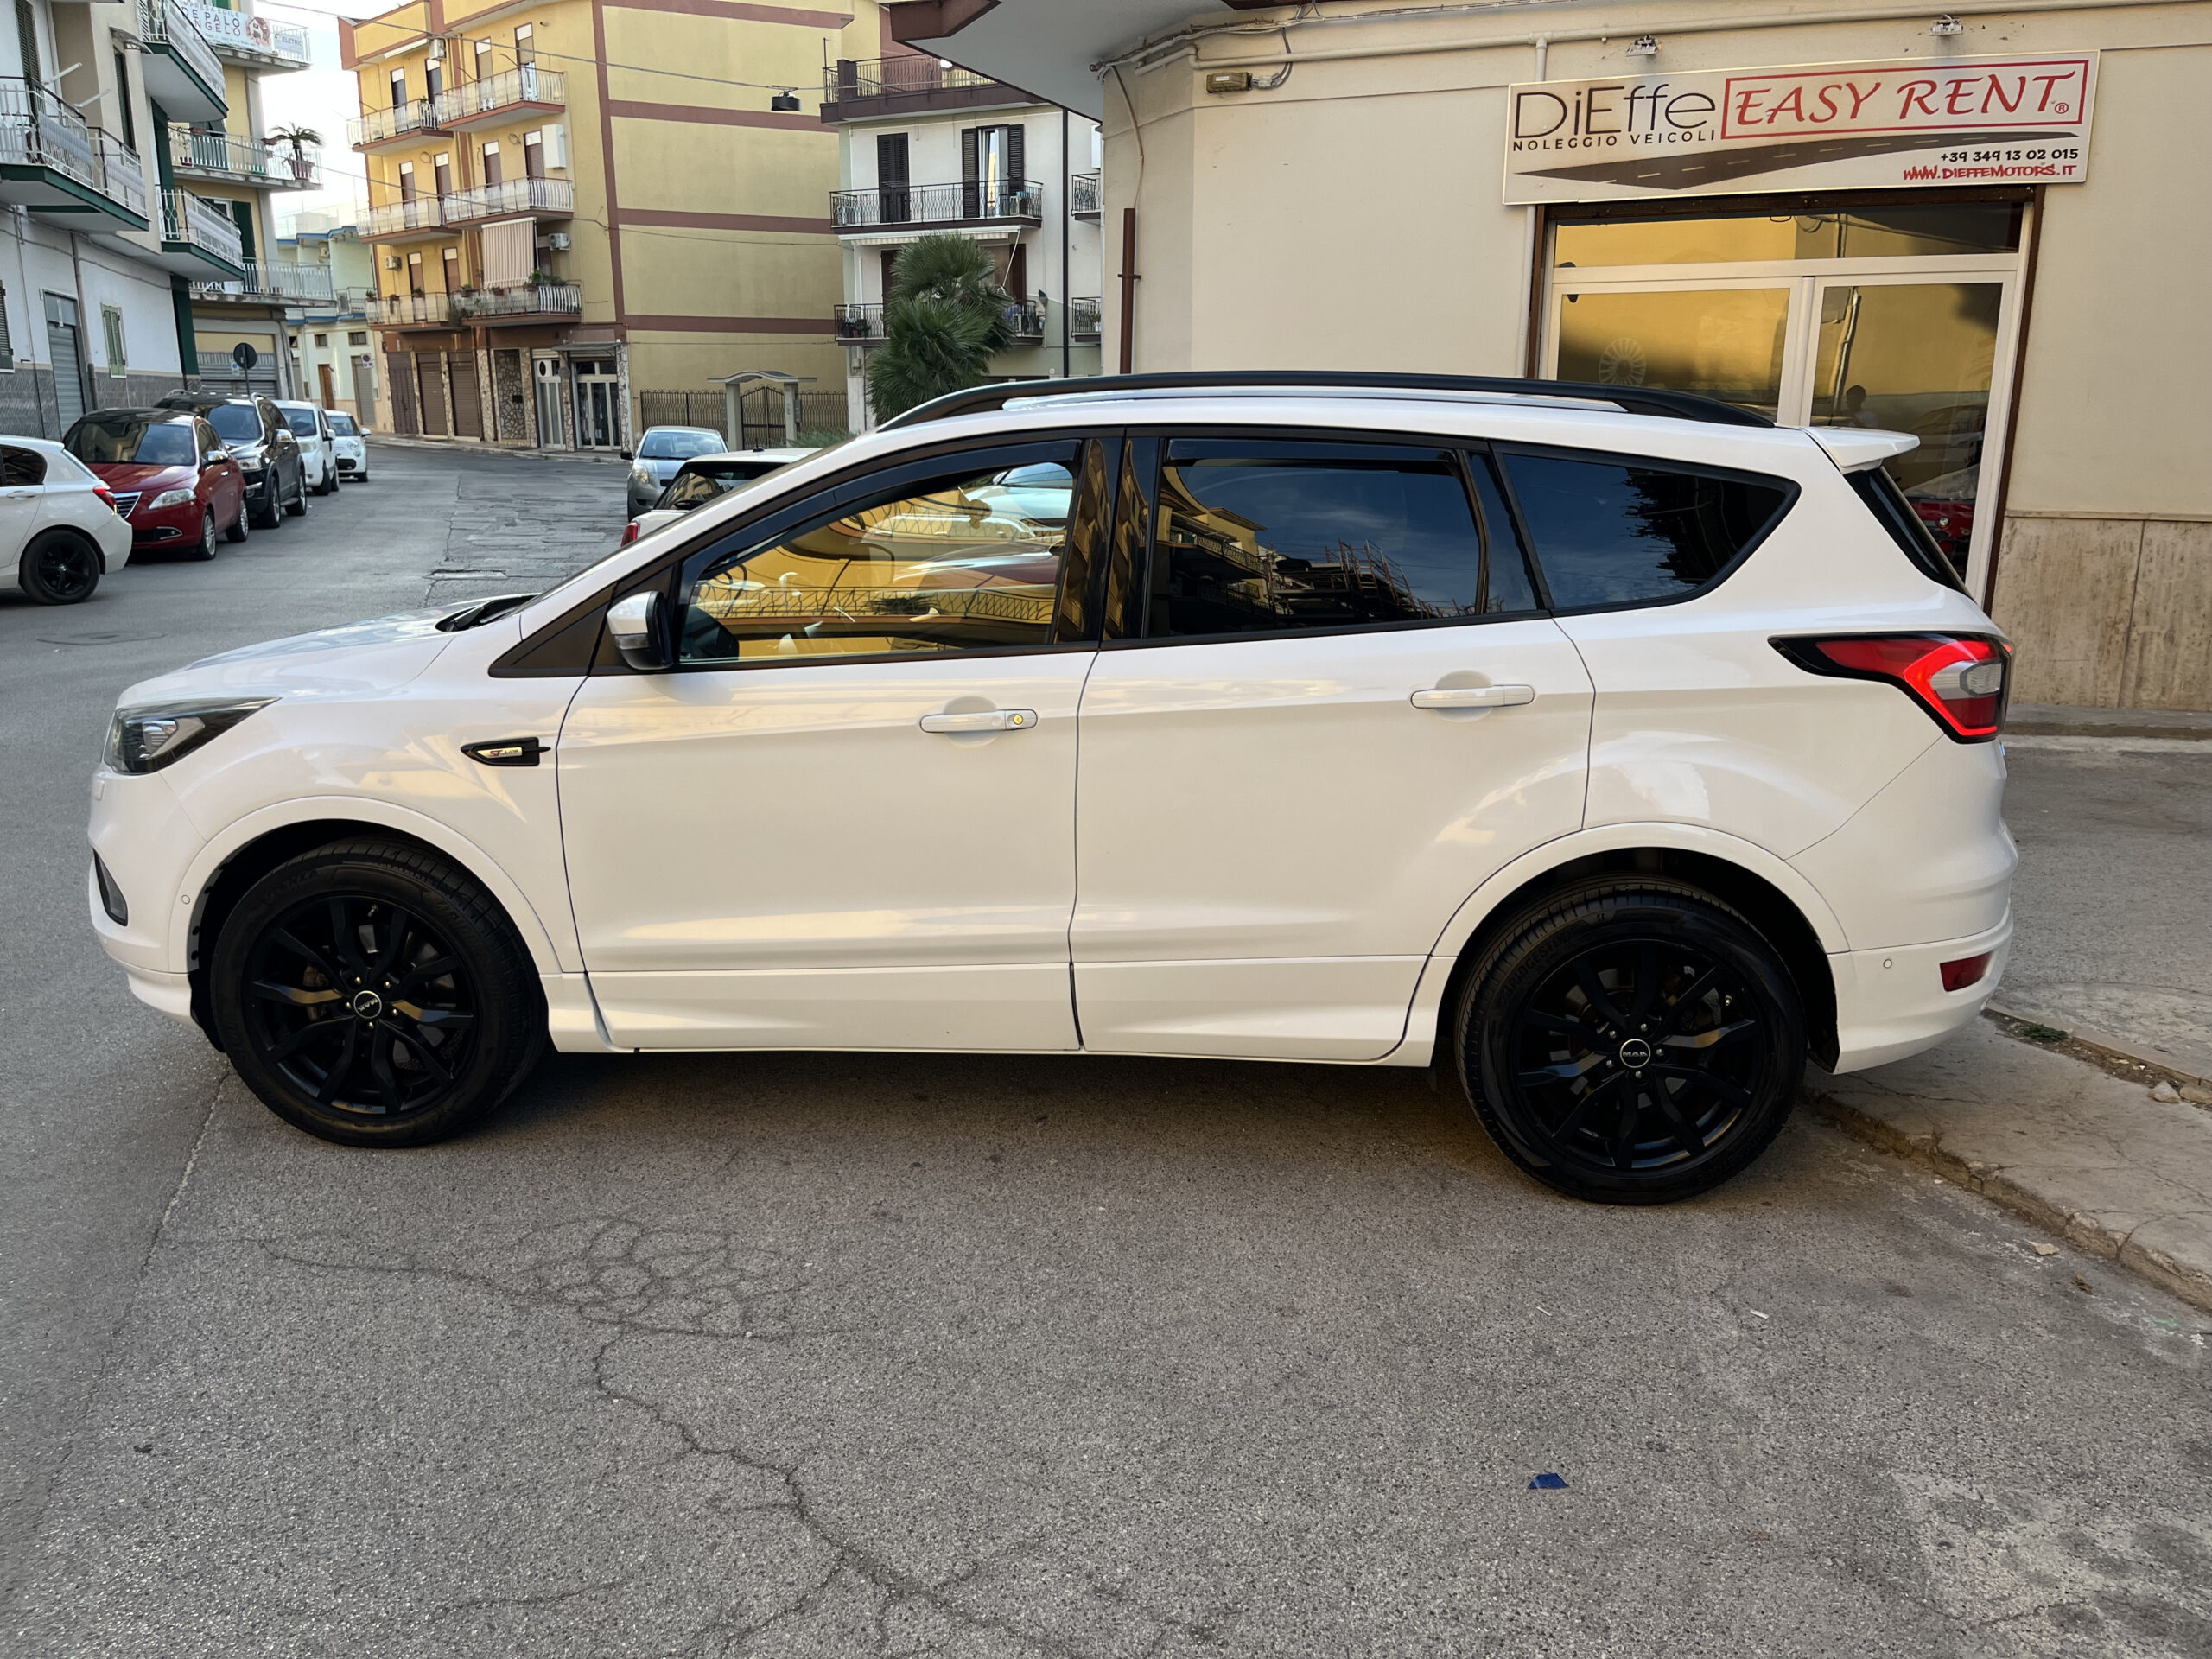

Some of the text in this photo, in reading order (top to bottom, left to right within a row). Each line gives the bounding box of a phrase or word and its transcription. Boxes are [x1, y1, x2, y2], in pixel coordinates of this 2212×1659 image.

[194, 19, 241, 36] NGELO
[204, 11, 240, 28] PALO
[1735, 70, 2076, 125] EASY RENT
[1514, 83, 1716, 139] DiEffe
[1512, 130, 1715, 152] NOLEGGIO VEICOLI
[1940, 148, 2080, 162] +39 349 13 02 015
